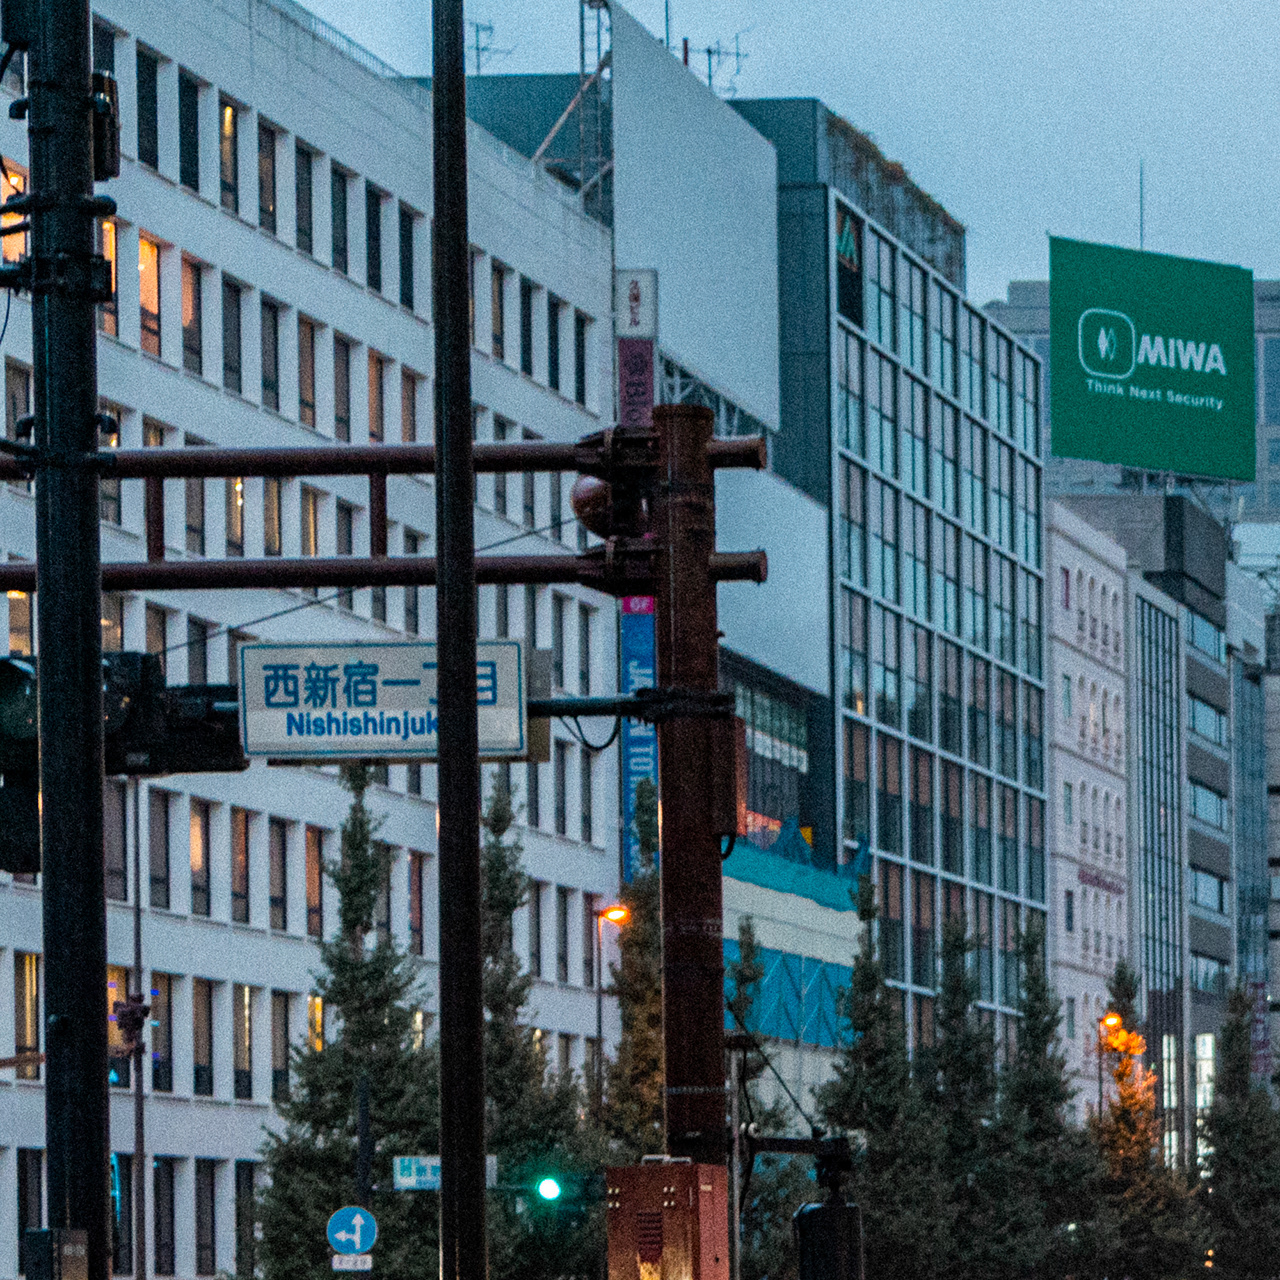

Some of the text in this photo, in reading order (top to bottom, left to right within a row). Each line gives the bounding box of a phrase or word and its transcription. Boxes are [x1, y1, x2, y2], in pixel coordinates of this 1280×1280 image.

[1137, 334, 1227, 376] MIWA
[1086, 378, 1223, 411] Think Next Security
[286, 711, 438, 740] Nishishinjuk
